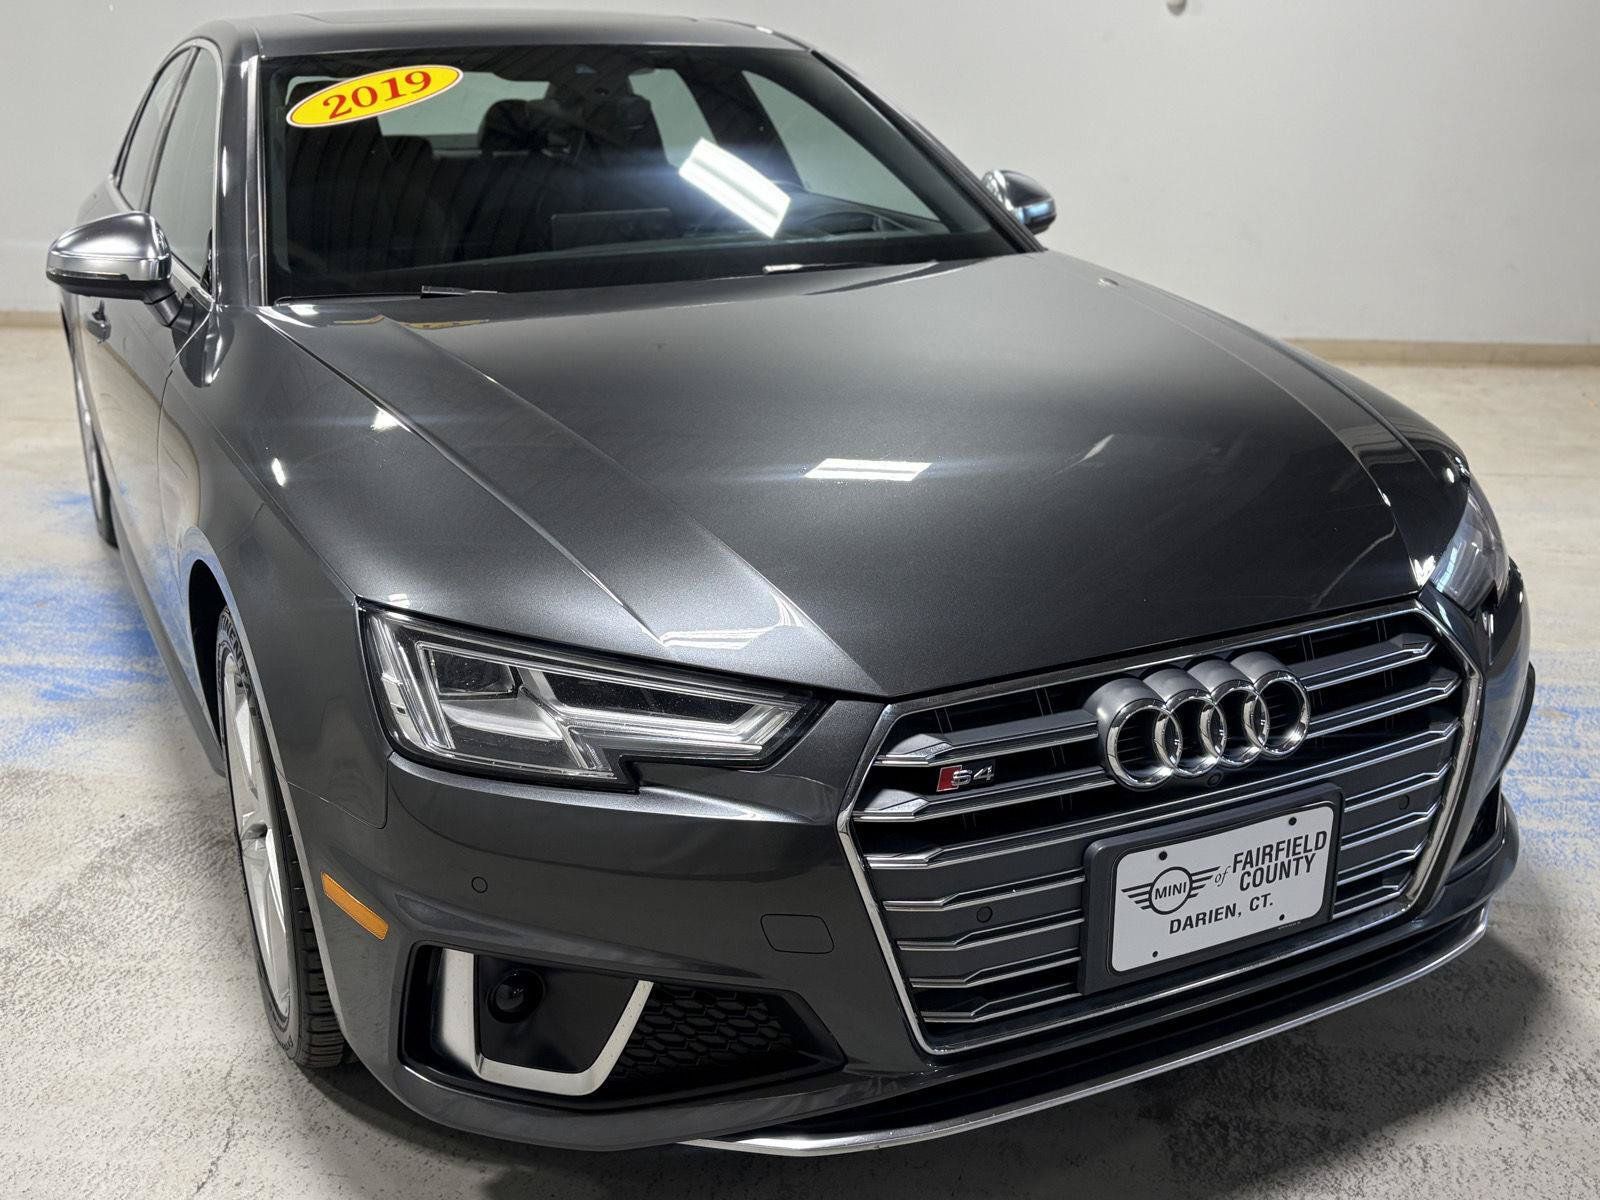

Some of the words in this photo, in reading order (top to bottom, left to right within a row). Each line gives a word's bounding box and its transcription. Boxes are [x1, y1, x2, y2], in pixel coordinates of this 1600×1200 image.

[323, 70, 432, 120] 2019
[951, 765, 994, 786] S4
[1154, 881, 1187, 900] MINI
[1214, 865, 1232, 887] of
[1232, 830, 1328, 874] FAIRFIELD
[1239, 853, 1316, 892] COUNTY
[1169, 903, 1242, 934] DARIEN,
[1249, 893, 1274, 912] CT.
